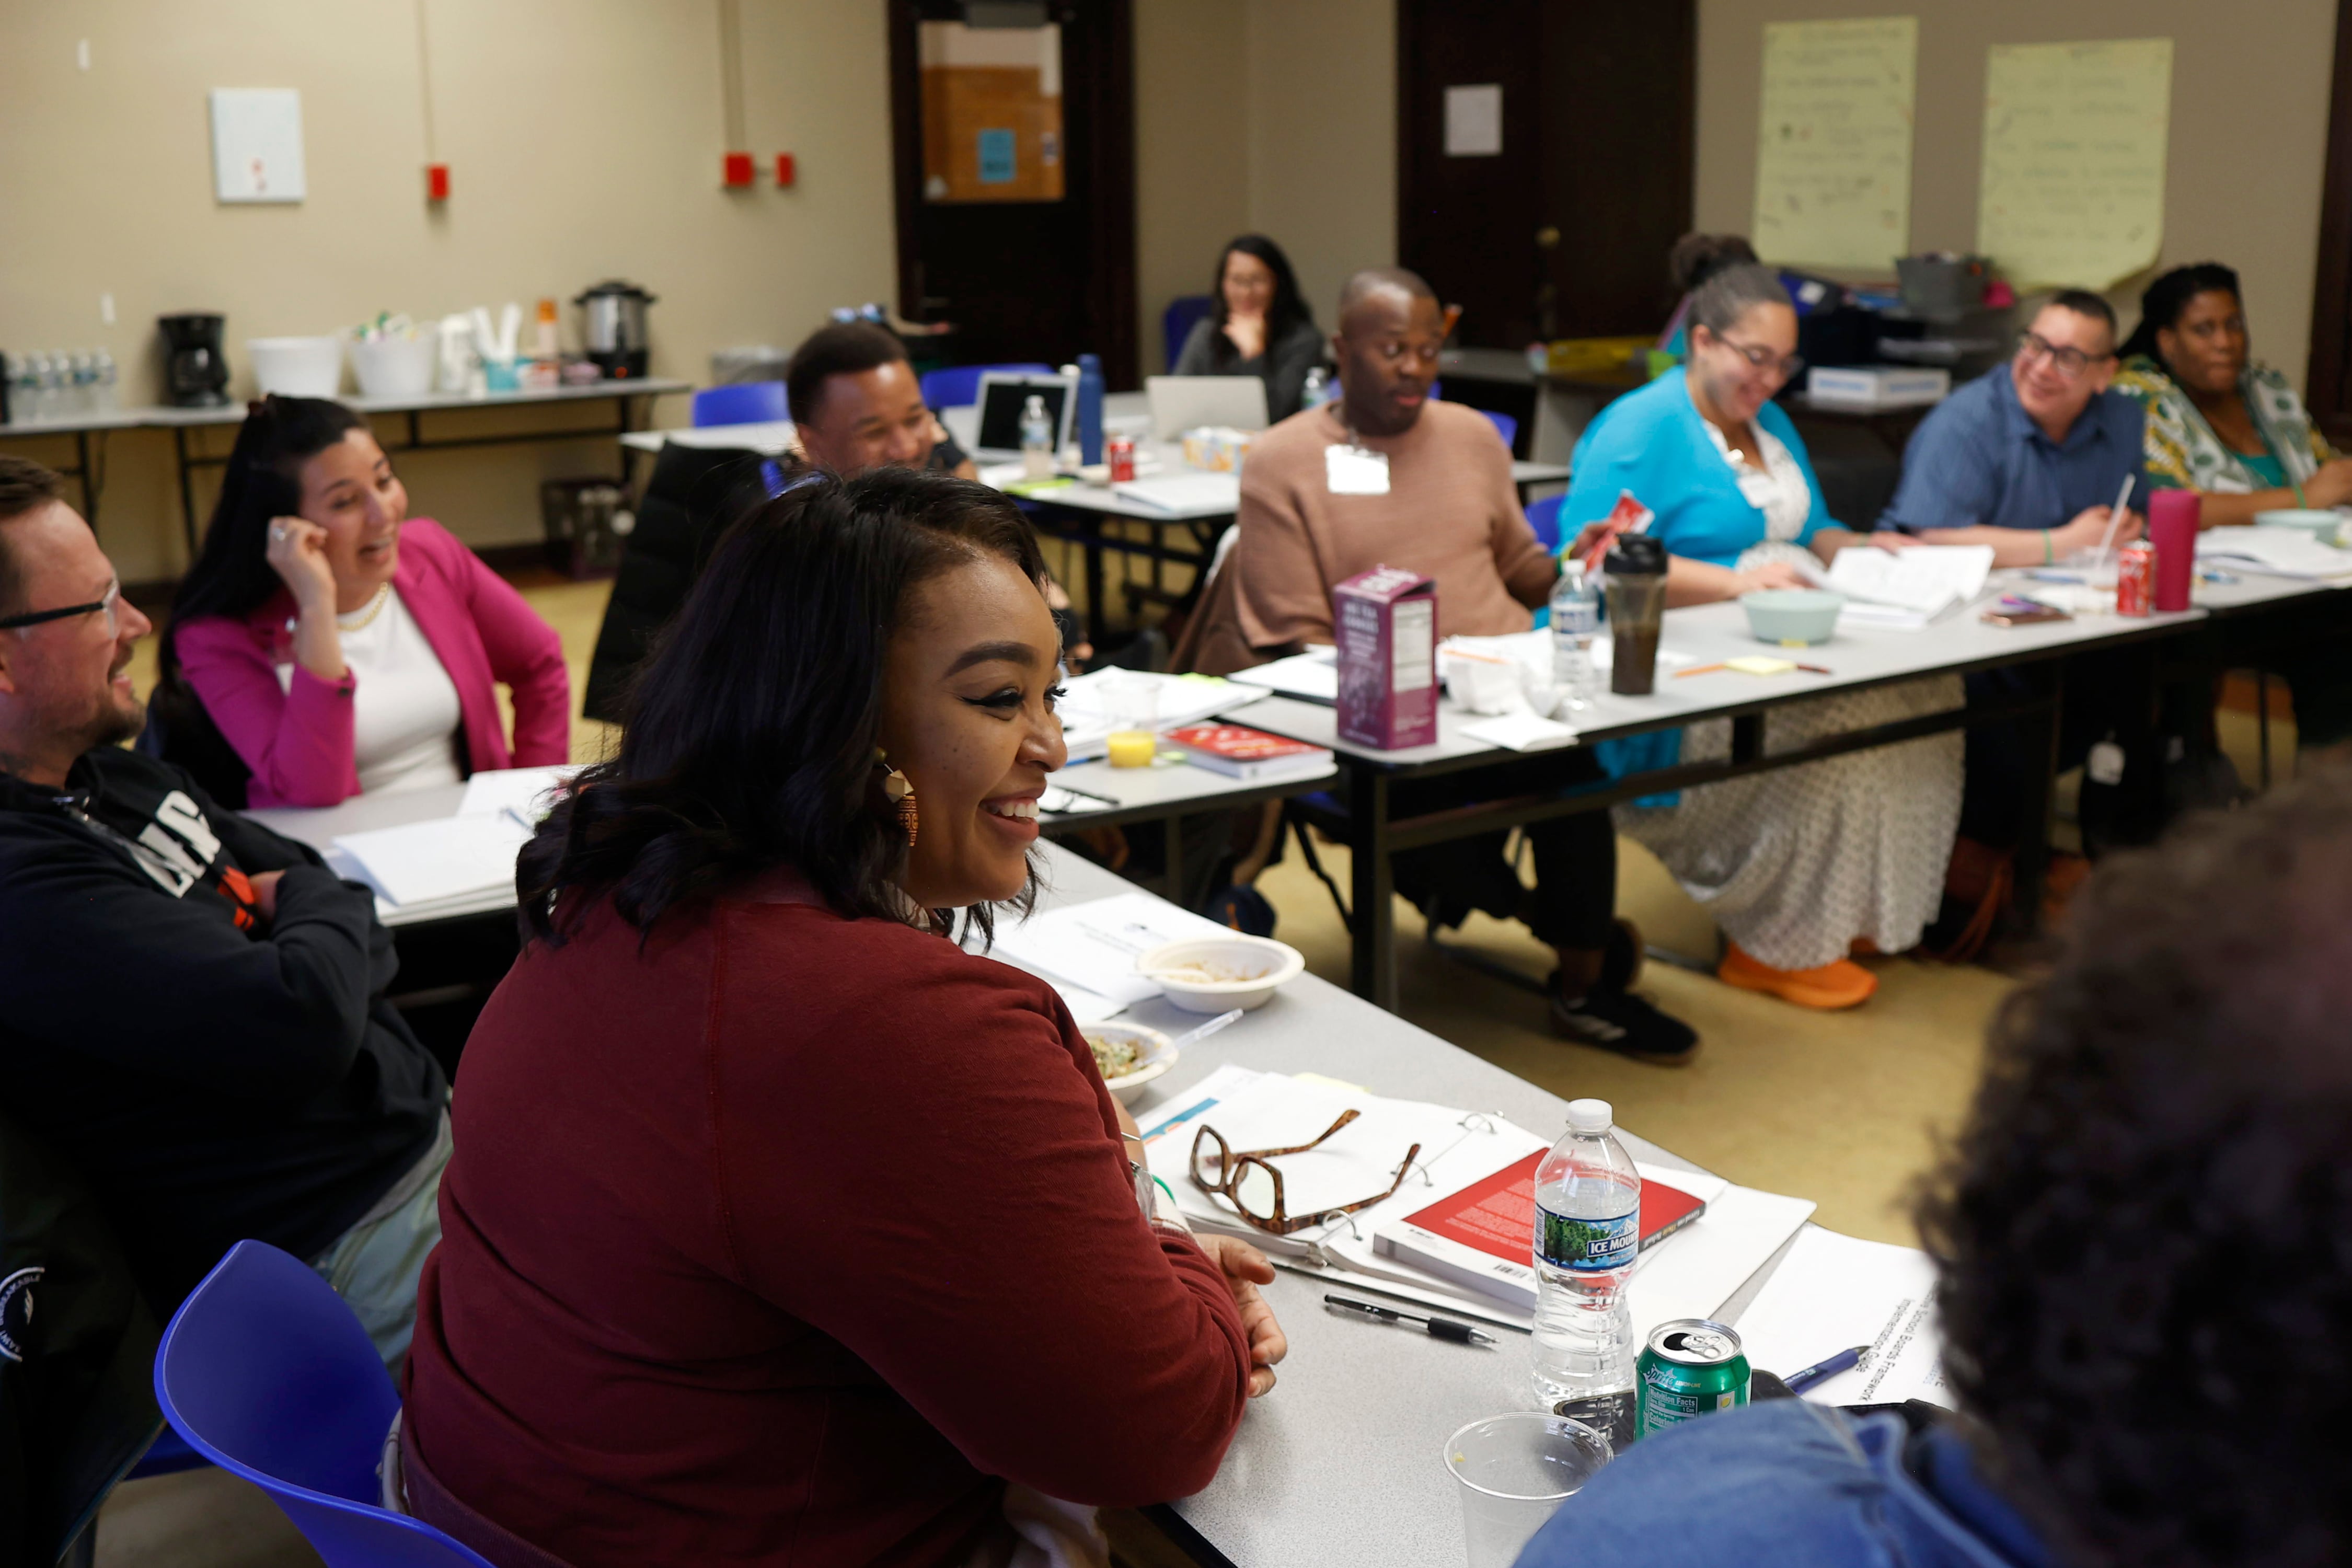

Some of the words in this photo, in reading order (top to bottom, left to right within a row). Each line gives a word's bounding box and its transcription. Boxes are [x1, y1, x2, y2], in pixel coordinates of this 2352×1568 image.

[1590, 1241, 1608, 1254] ICE
[1886, 1334, 1912, 1360] Boards
[1646, 1366, 1675, 1386] Sprite
[1858, 1360, 1896, 1401] Framework
[1650, 1388, 1675, 1404] Nutrition
[1676, 1397, 1696, 1406] Facts
